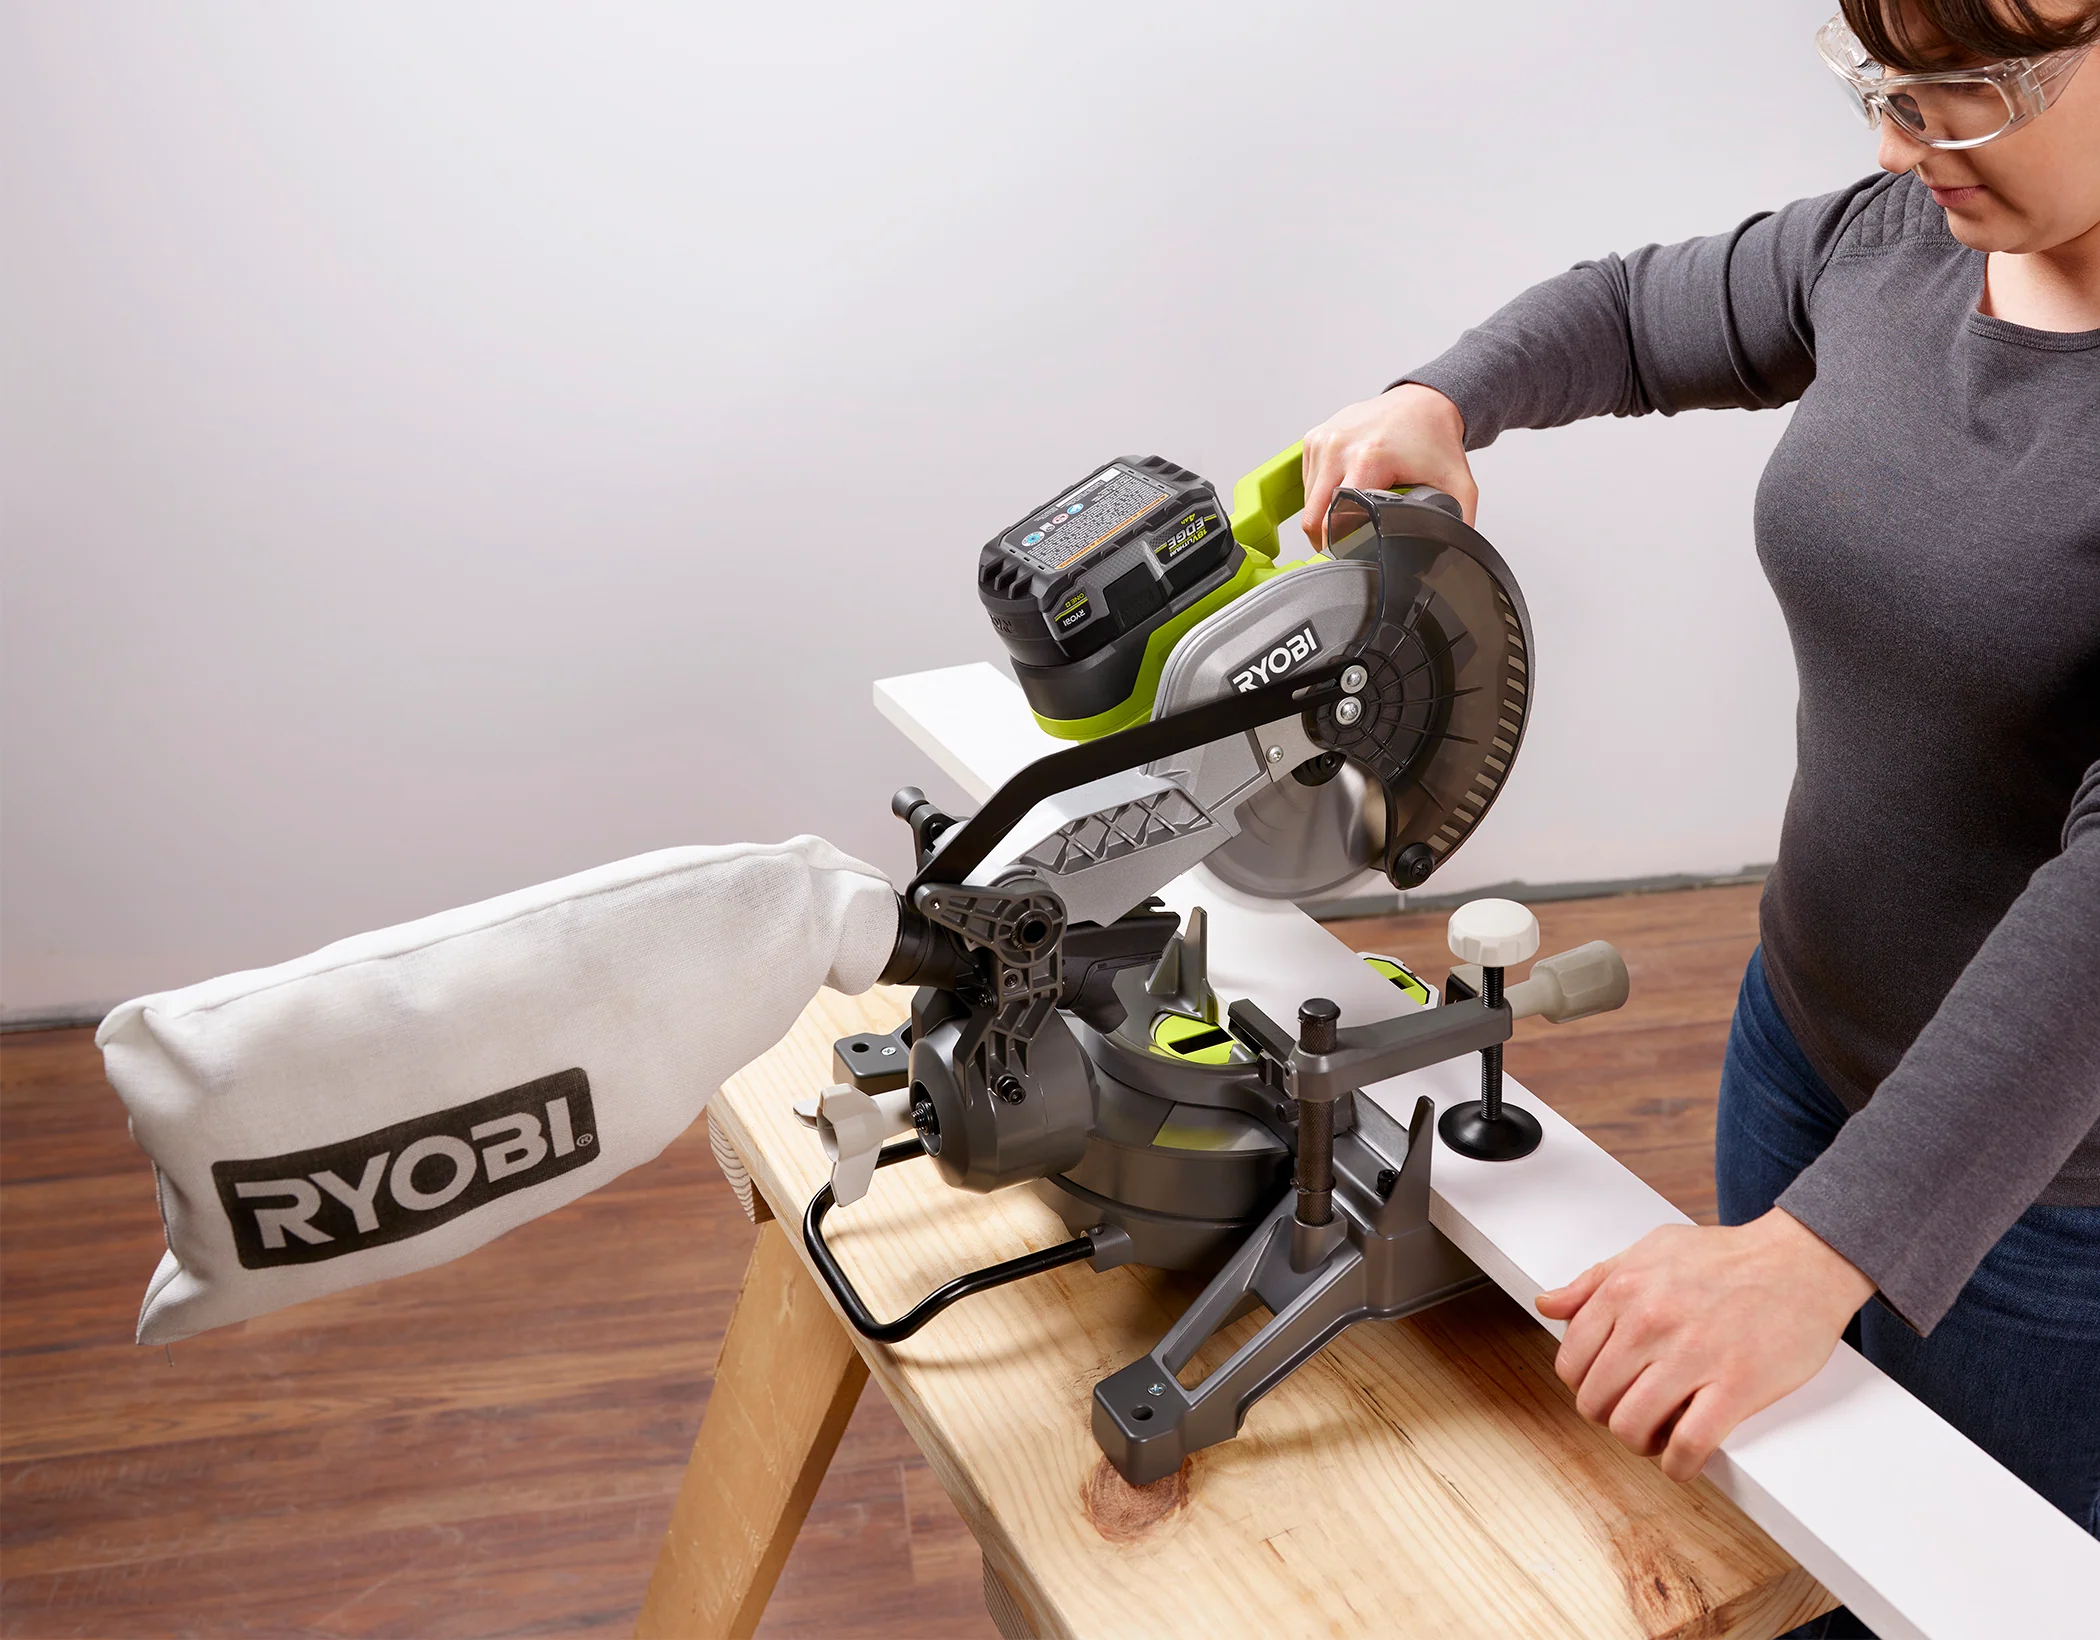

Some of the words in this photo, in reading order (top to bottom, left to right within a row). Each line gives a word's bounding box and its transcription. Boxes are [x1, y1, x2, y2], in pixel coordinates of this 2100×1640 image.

[1167, 516, 1205, 550] EDGE
[1062, 609, 1086, 627] RYOBI
[1232, 627, 1318, 694] RYOBI
